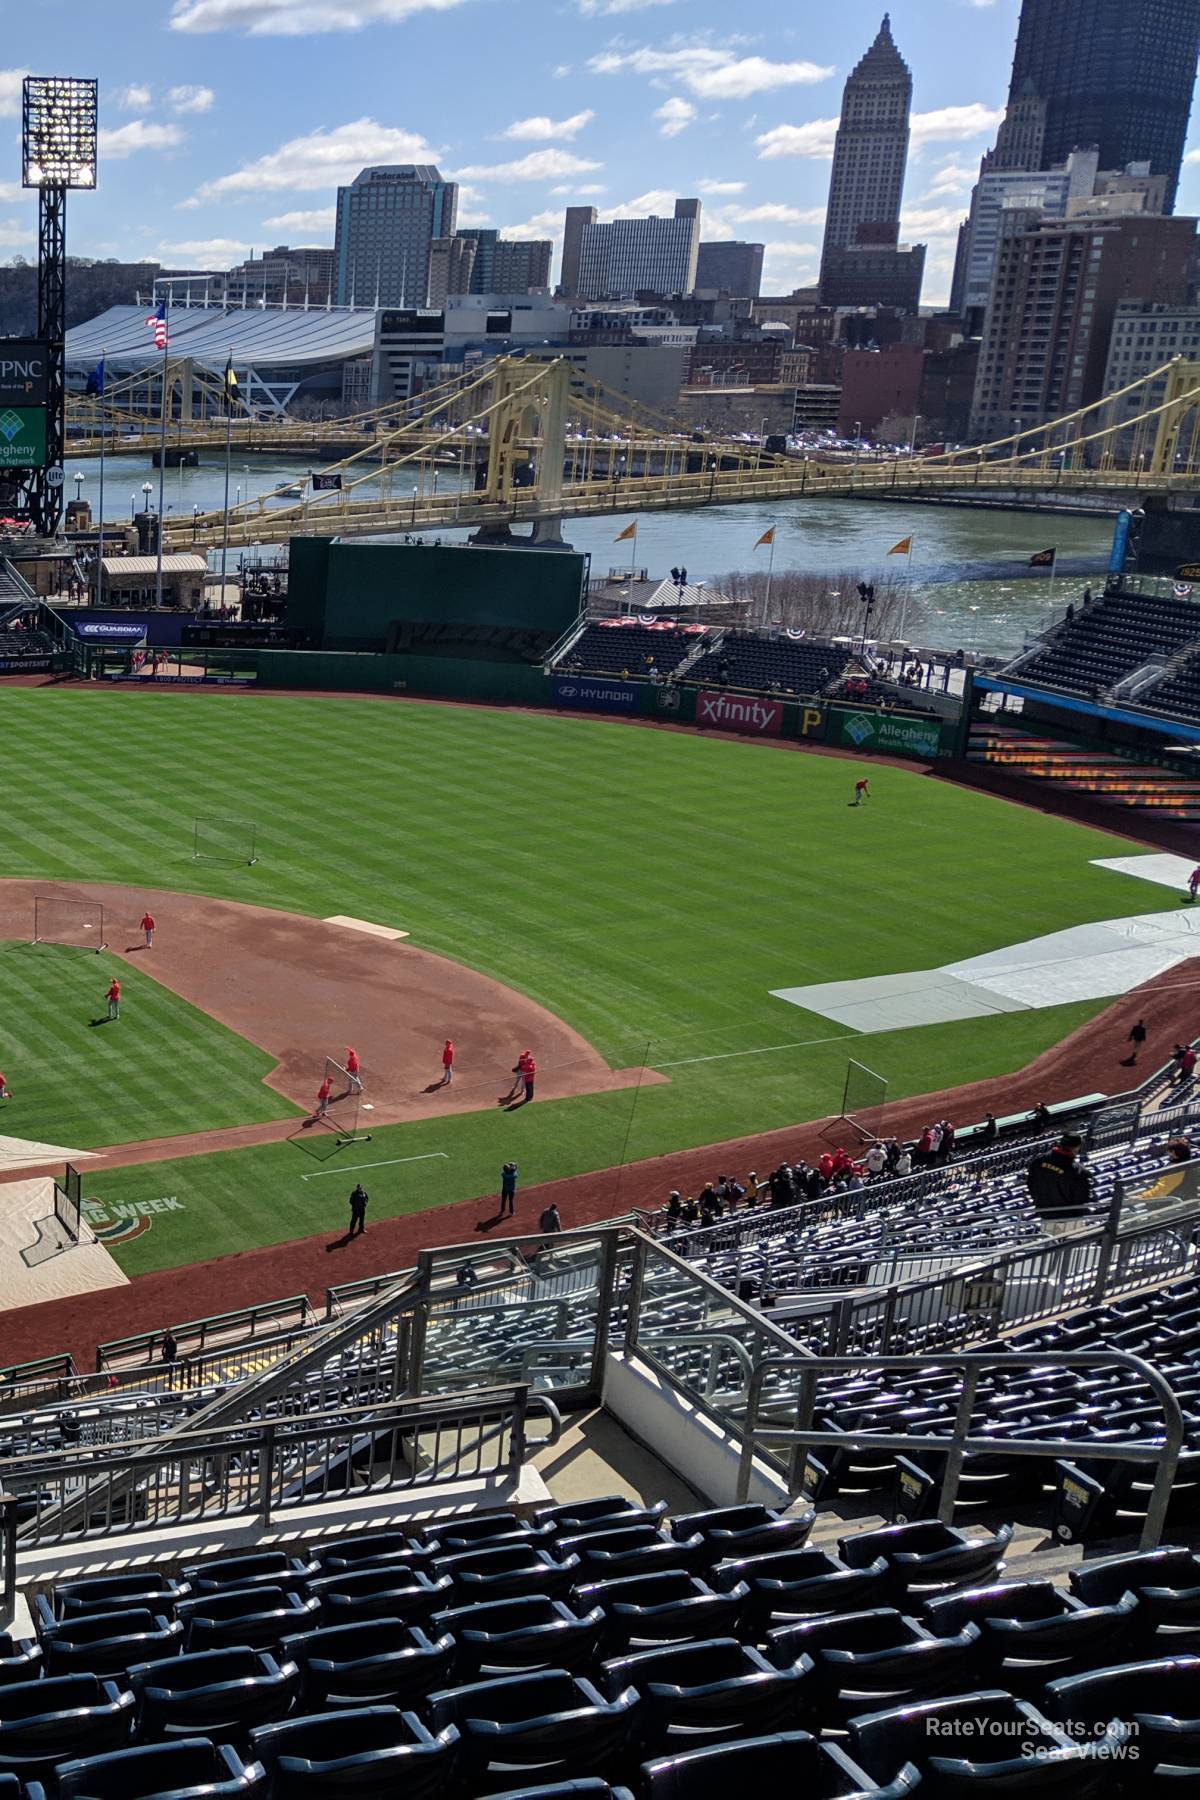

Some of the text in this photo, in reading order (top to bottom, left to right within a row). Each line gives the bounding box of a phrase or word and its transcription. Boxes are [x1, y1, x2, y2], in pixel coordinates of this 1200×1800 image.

[370, 171, 416, 180] Federated
[0, 360, 43, 378] PNC
[6, 457, 35, 466] Network
[48, 471, 63, 481] Lite
[99, 625, 144, 634] GUARDIAN
[9, 660, 50, 669] SPORTSNET
[580, 687, 634, 703] HYUNDAI
[701, 698, 776, 730] xfinity
[802, 708, 822, 735] P
[878, 723, 939, 743] Allegheny
[1041, 1161, 1065, 1175] STAFF
[111, 1196, 186, 1220] WEEK
